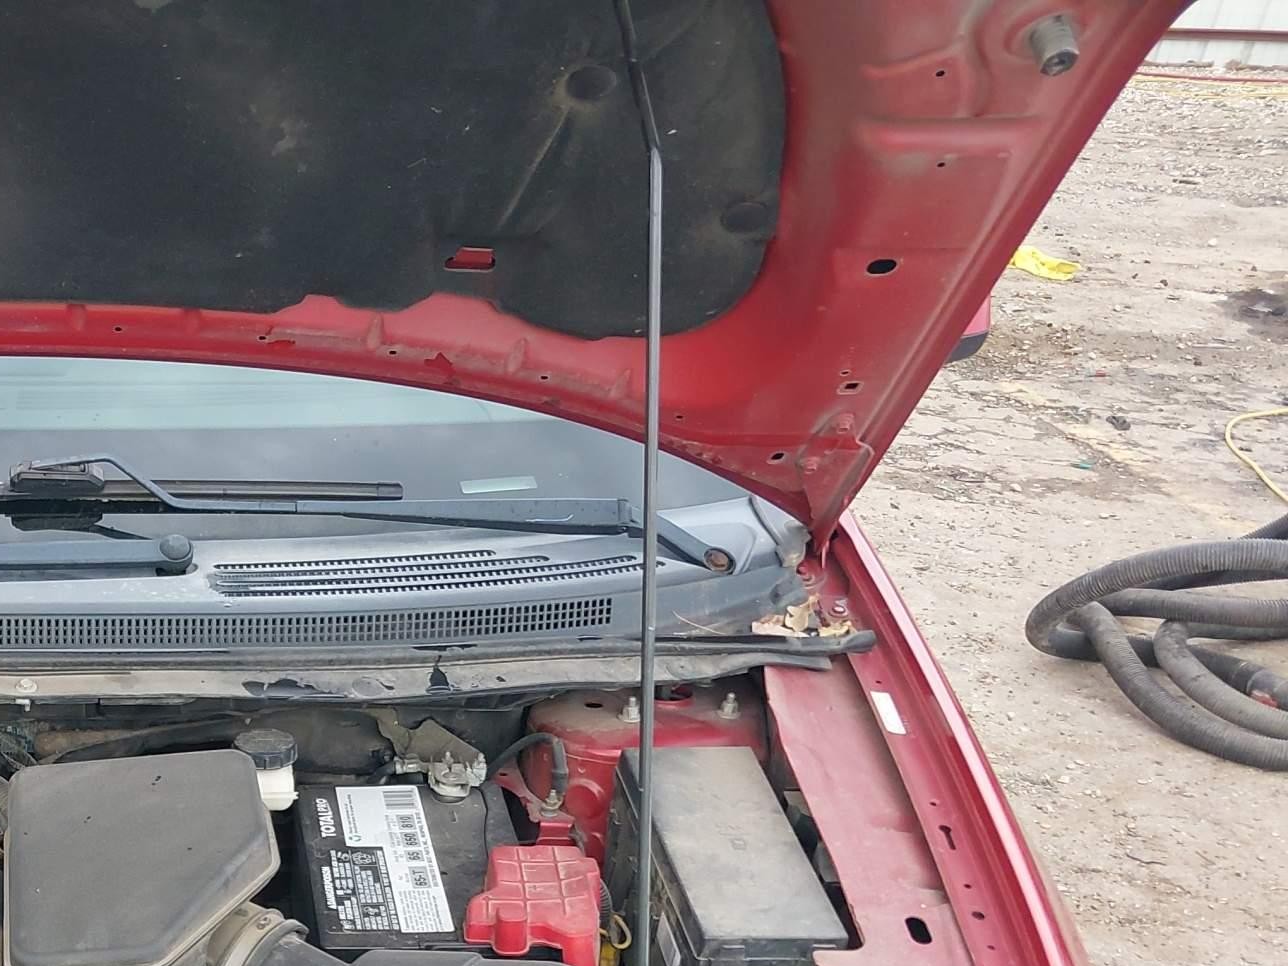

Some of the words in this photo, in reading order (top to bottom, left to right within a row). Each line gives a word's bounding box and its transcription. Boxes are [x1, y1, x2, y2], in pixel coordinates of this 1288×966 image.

[399, 816, 414, 829] 810
[403, 833, 418, 846] 650
[408, 851, 422, 861] 65
[412, 869, 428, 887] 65-T
